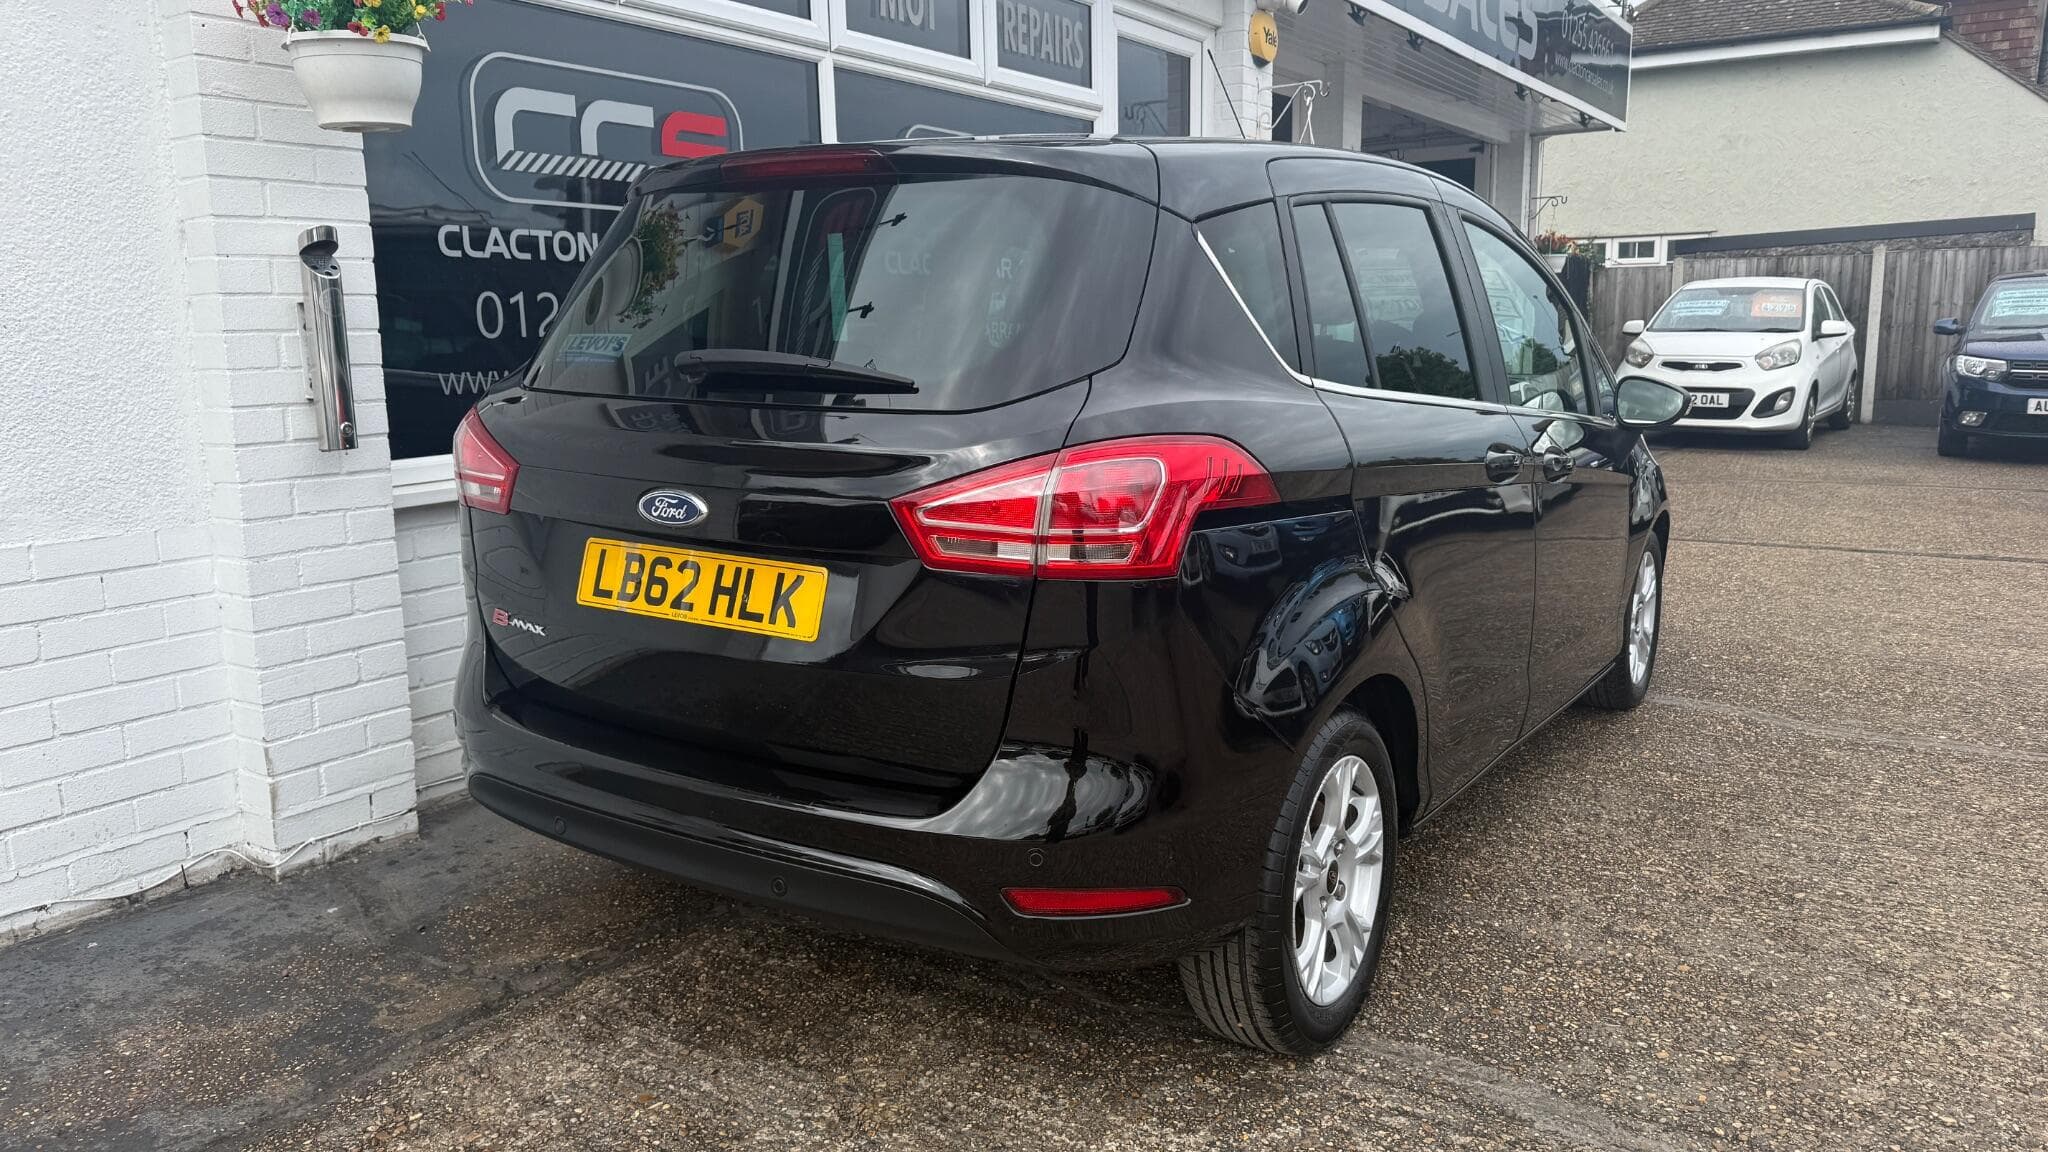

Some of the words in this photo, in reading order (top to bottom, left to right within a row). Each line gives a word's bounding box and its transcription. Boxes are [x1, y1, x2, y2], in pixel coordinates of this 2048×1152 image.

[1004, 3, 1084, 69] REPAIRS
[1263, 26, 1277, 48] Yale
[1562, 9, 1588, 50] 01255
[438, 225, 598, 262] CLACTON
[438, 371, 509, 395] ww
[1701, 395, 1724, 406] OAL
[651, 496, 687, 520] Ford
[592, 549, 701, 612] LB62
[709, 564, 806, 629] HLK
